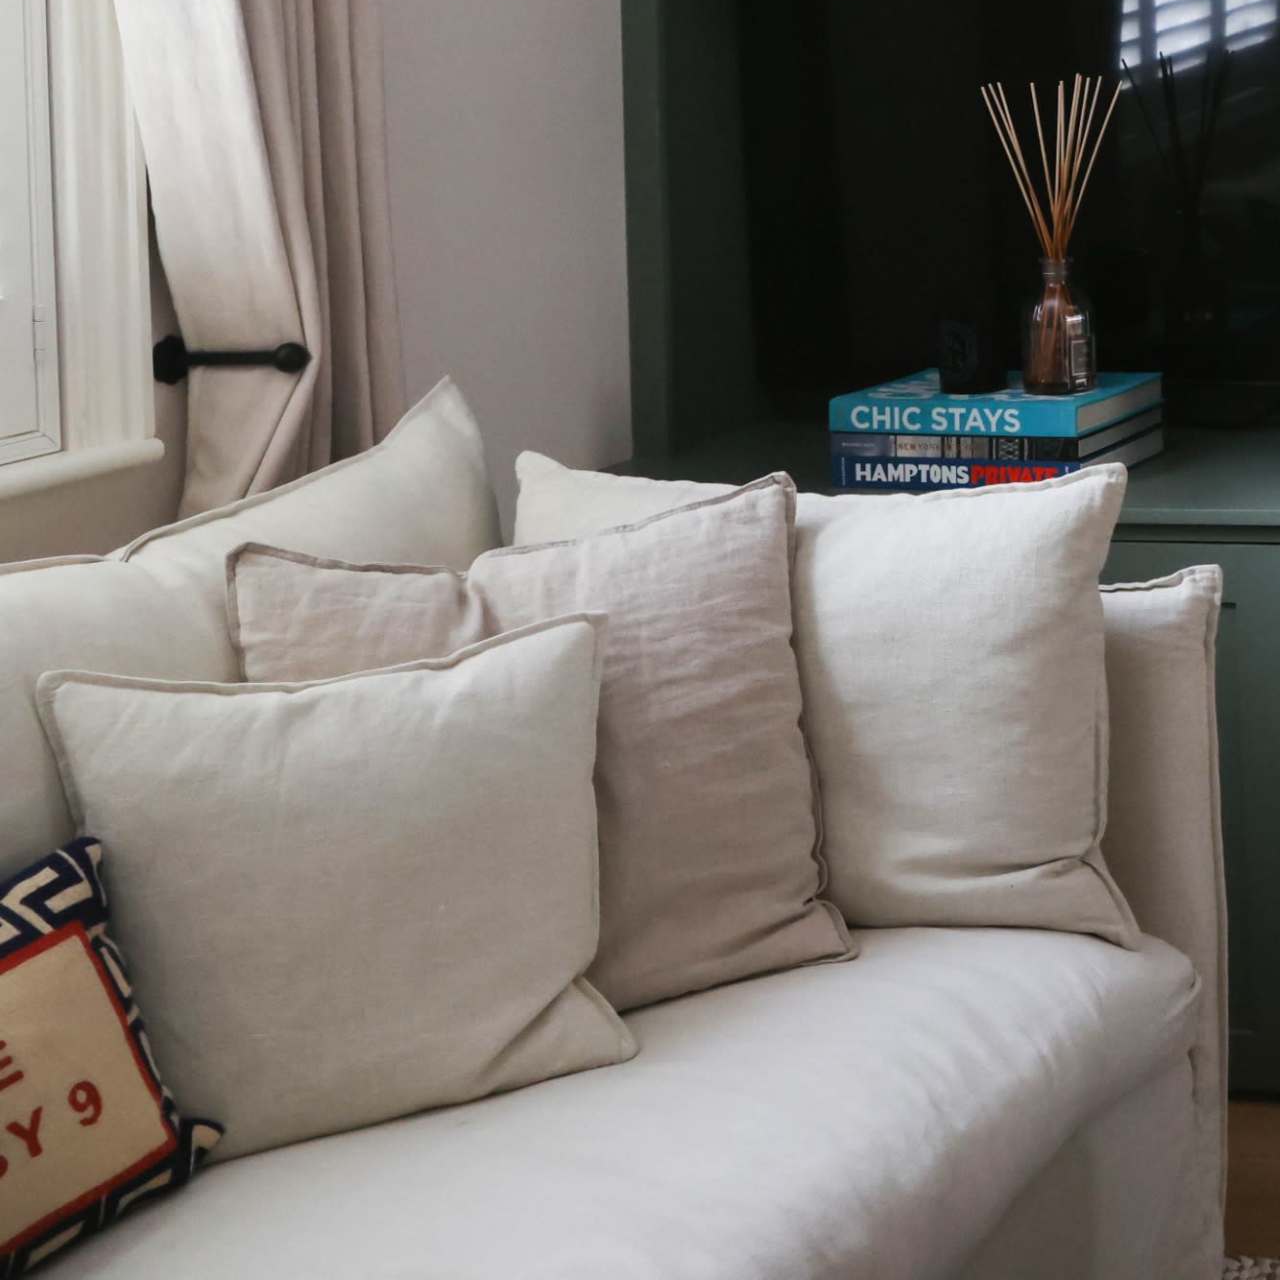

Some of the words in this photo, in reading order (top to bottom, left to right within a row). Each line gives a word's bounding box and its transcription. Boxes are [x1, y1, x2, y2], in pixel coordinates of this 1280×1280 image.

[850, 405, 922, 432] CHIC
[930, 406, 1022, 434] STAYS
[854, 462, 970, 485] HAMPTONS
[67, 1080, 104, 1128] 9
